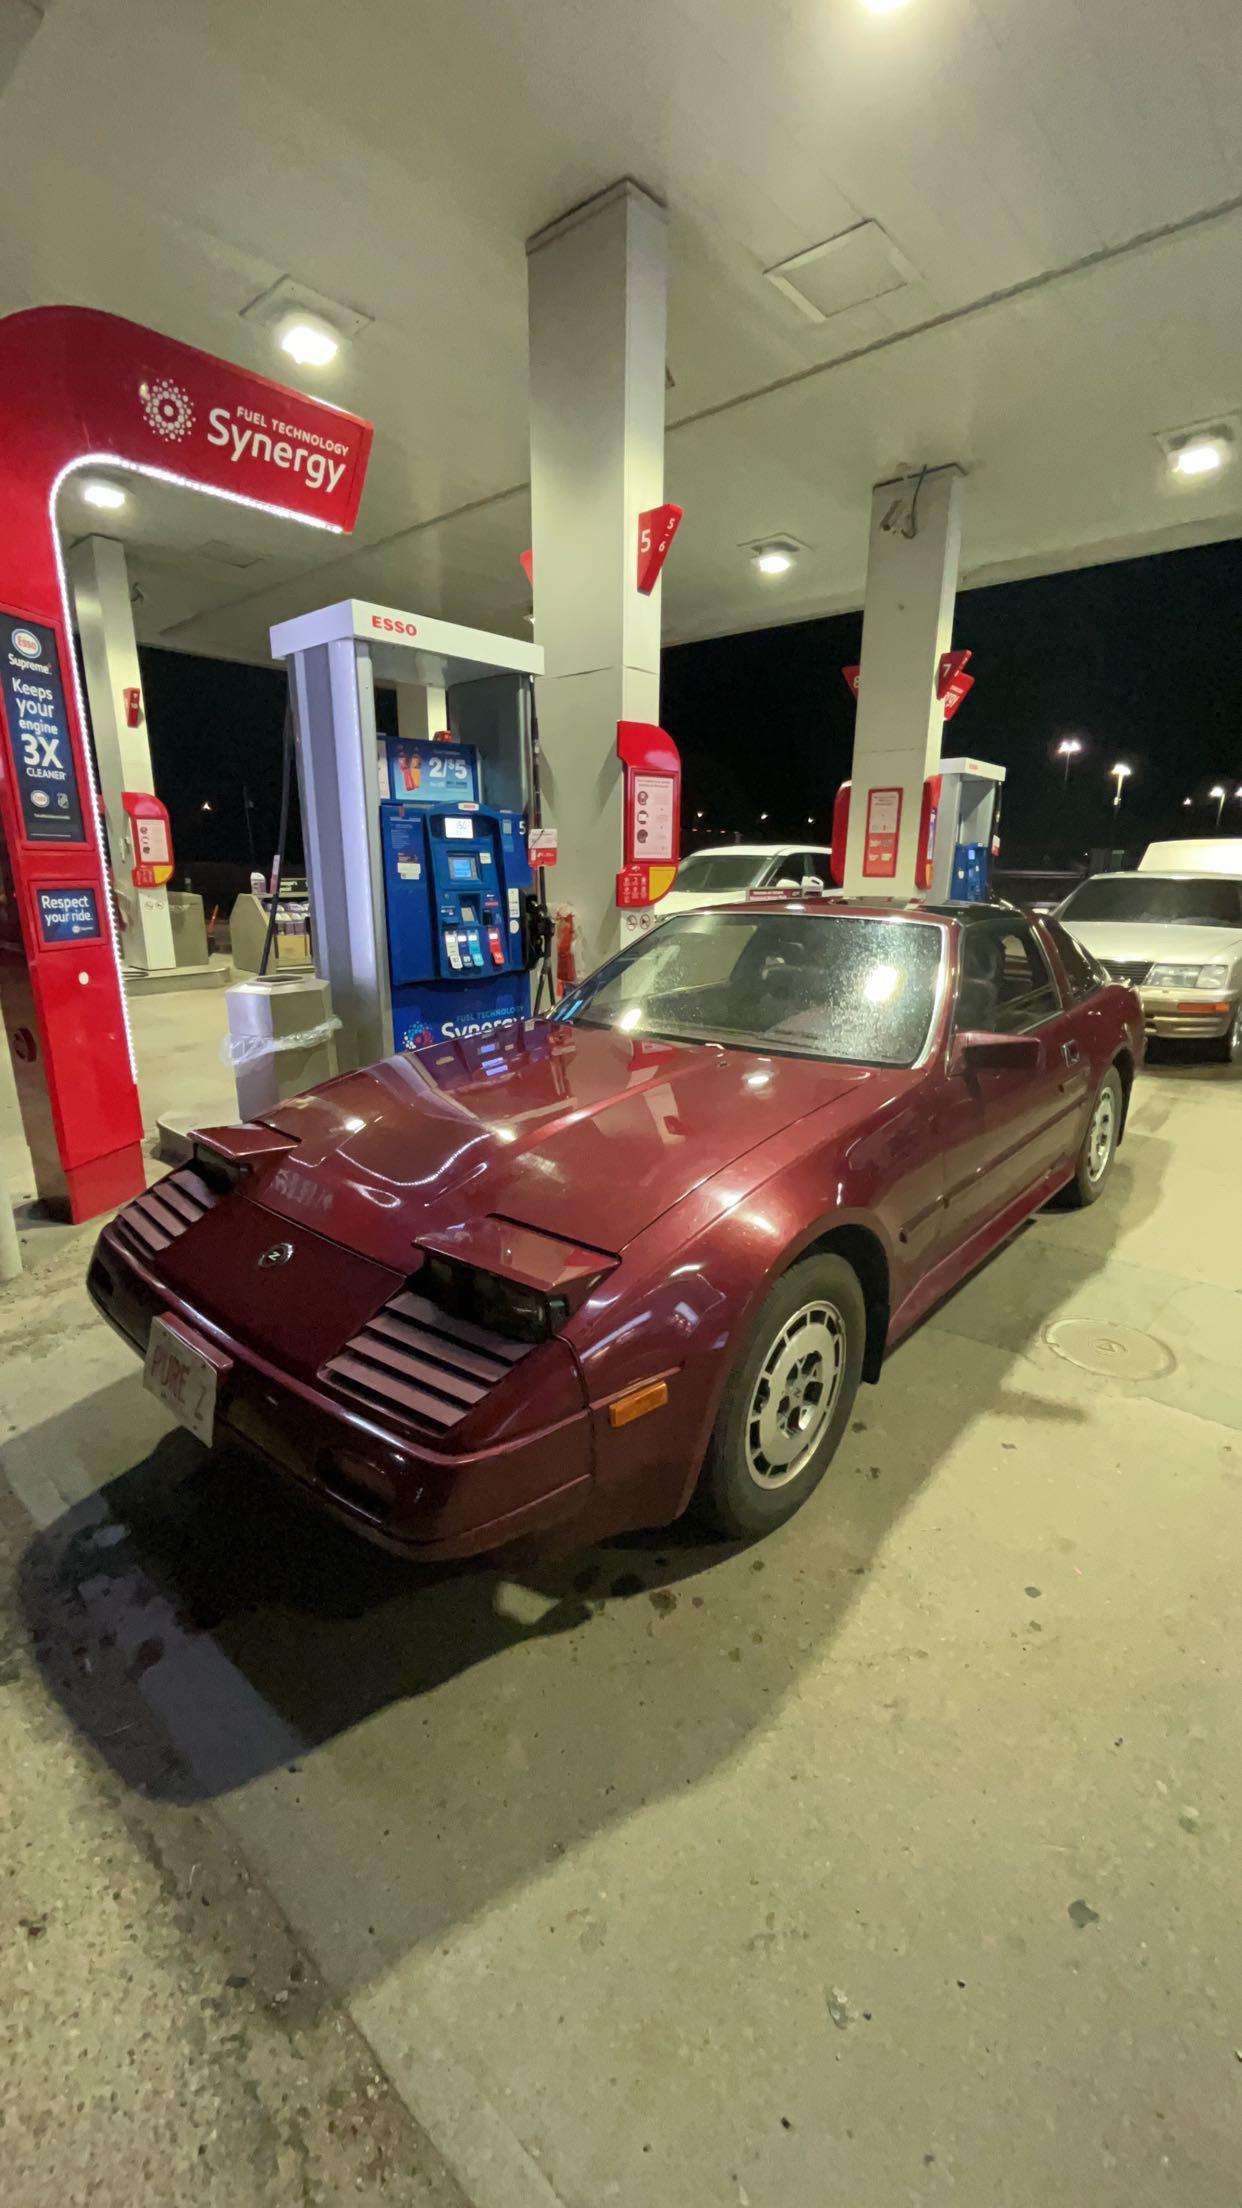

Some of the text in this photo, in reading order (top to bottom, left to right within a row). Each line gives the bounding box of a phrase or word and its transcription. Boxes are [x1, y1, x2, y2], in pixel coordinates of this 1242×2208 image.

[236, 406, 350, 457] FUEL TECHNOLOGY
[207, 407, 346, 493] Synergy
[667, 518, 676, 530] 5
[641, 529, 651, 553] 5
[658, 541, 666, 552] 6
[371, 615, 417, 637] ESSO
[943, 664, 951, 677] 7
[12, 677, 53, 701] Keeps
[16, 698, 54, 718] your
[19, 719, 58, 735] engine
[21, 733, 64, 769] 3X
[26, 767, 66, 780] CLEANER
[519, 820, 526, 835] 5
[41, 895, 90, 912] Respect
[44, 909, 94, 927] your ride.
